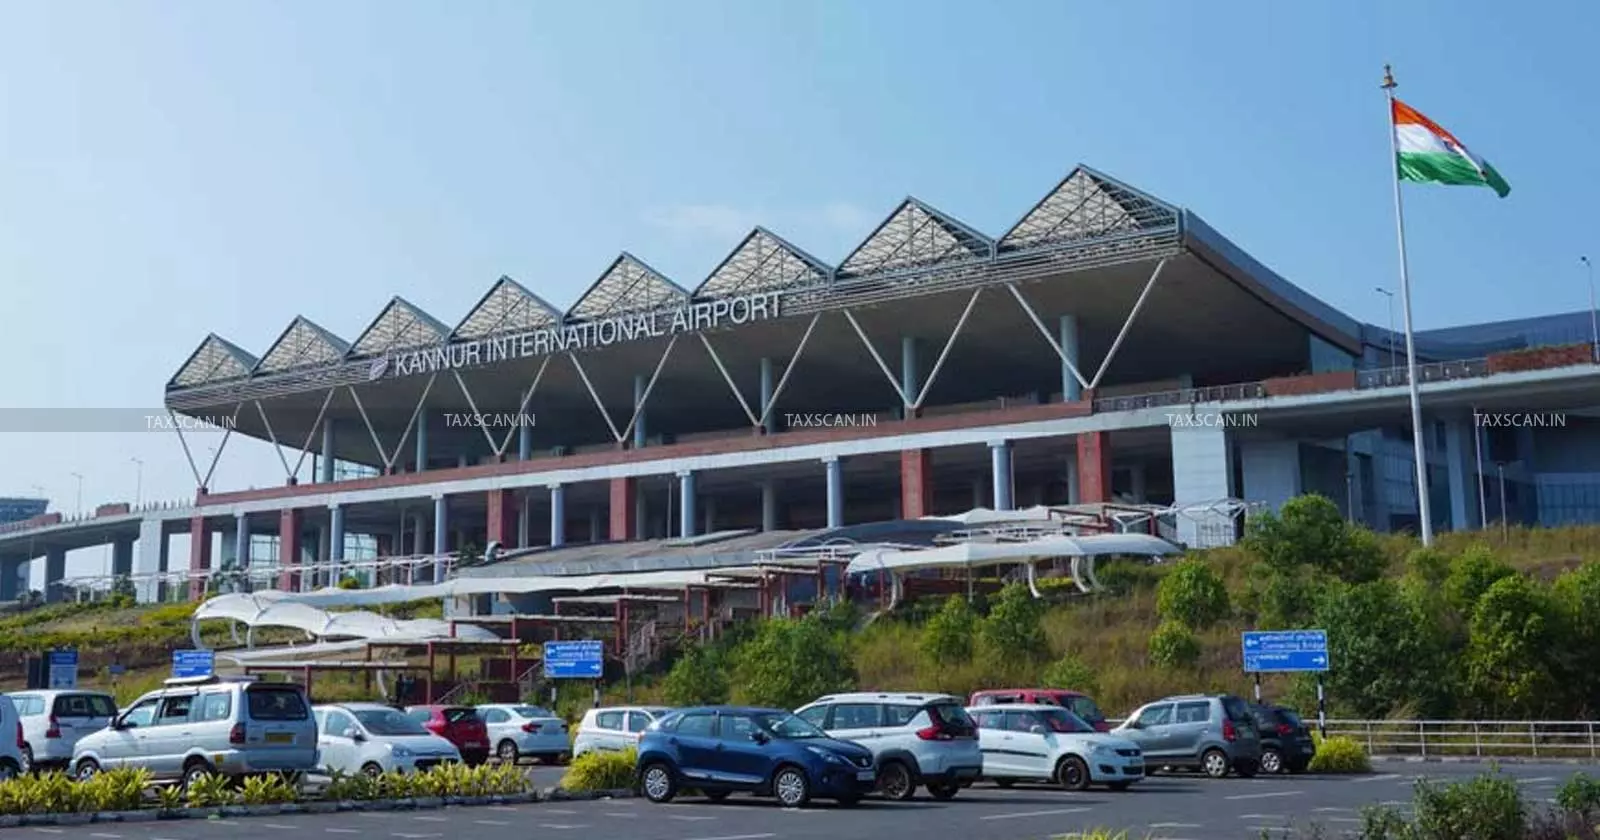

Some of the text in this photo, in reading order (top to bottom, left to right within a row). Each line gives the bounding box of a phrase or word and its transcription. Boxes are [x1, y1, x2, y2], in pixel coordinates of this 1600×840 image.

[395, 290, 784, 377] KANNUR INTERNATIONAL AIRPORT
